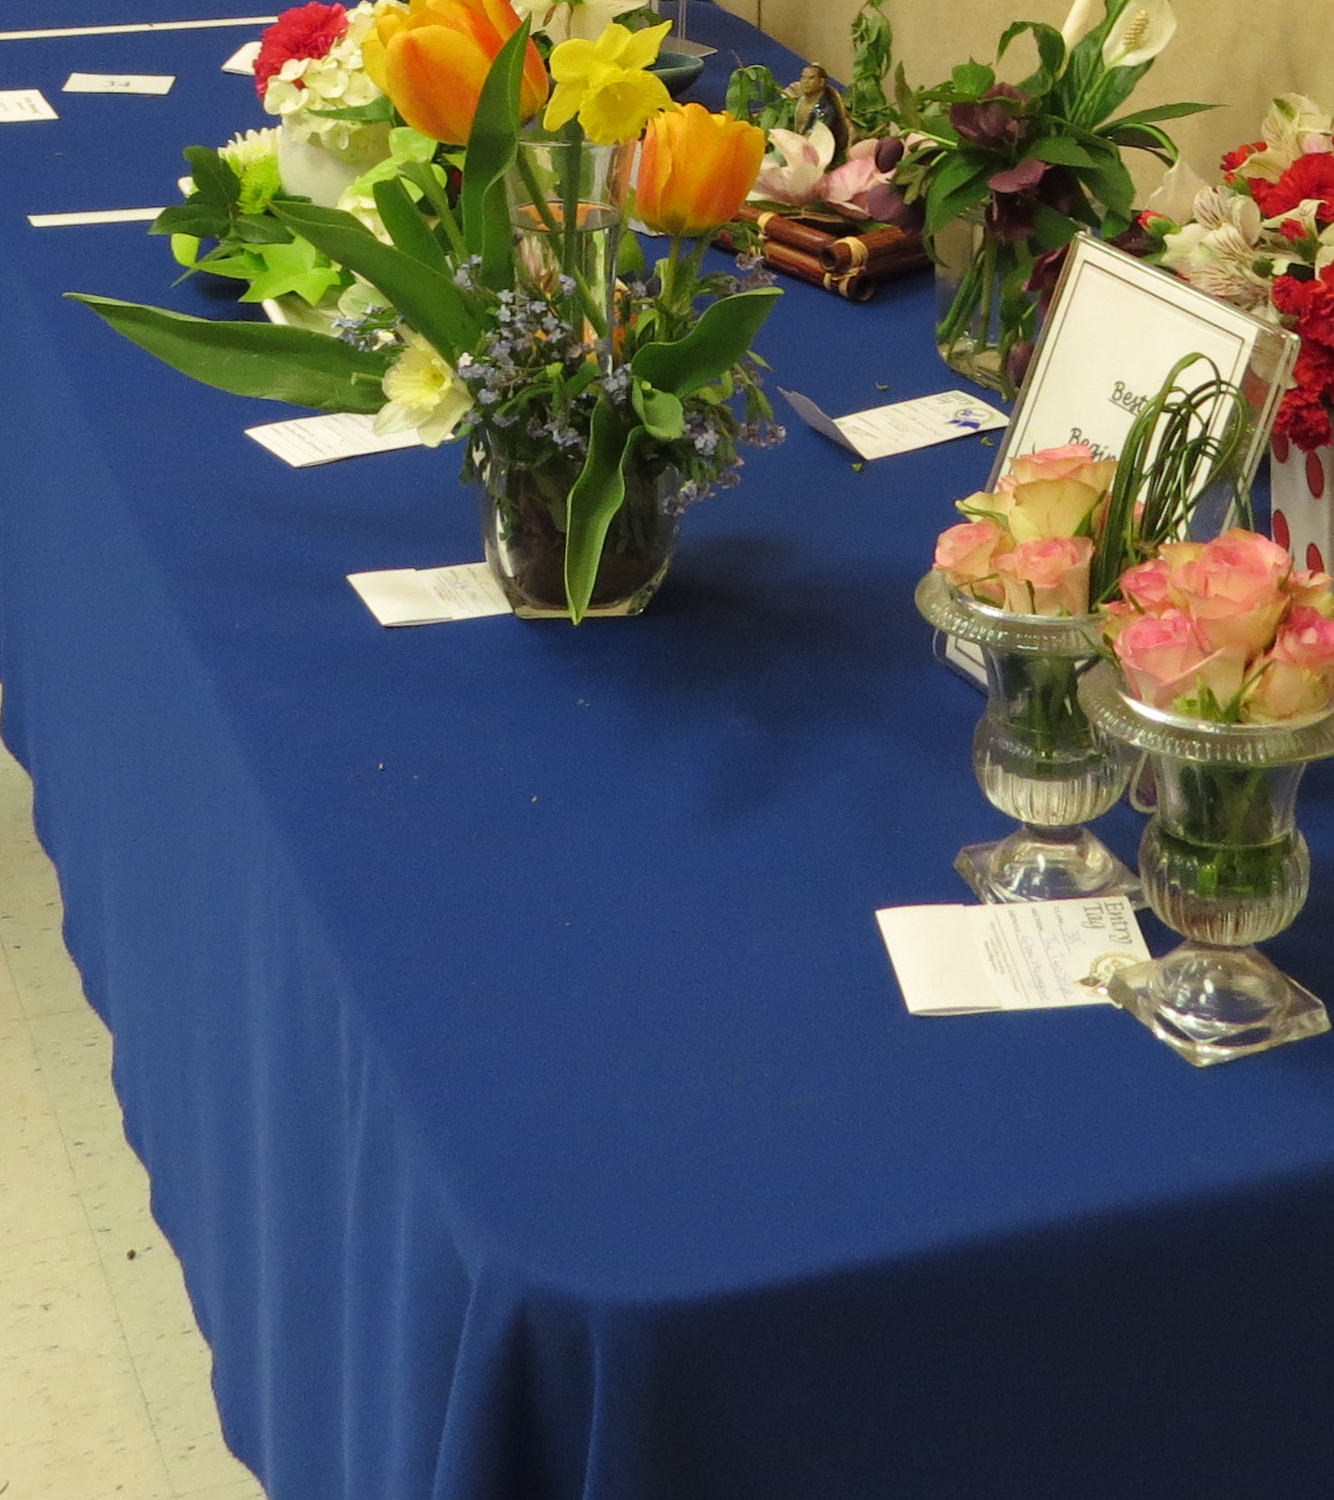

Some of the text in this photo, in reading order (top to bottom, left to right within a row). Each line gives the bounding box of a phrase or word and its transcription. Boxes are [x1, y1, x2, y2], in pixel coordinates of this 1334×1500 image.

[1111, 381, 1148, 413] Best
[1081, 902, 1105, 929] Tag
[1104, 902, 1133, 944] Entry
